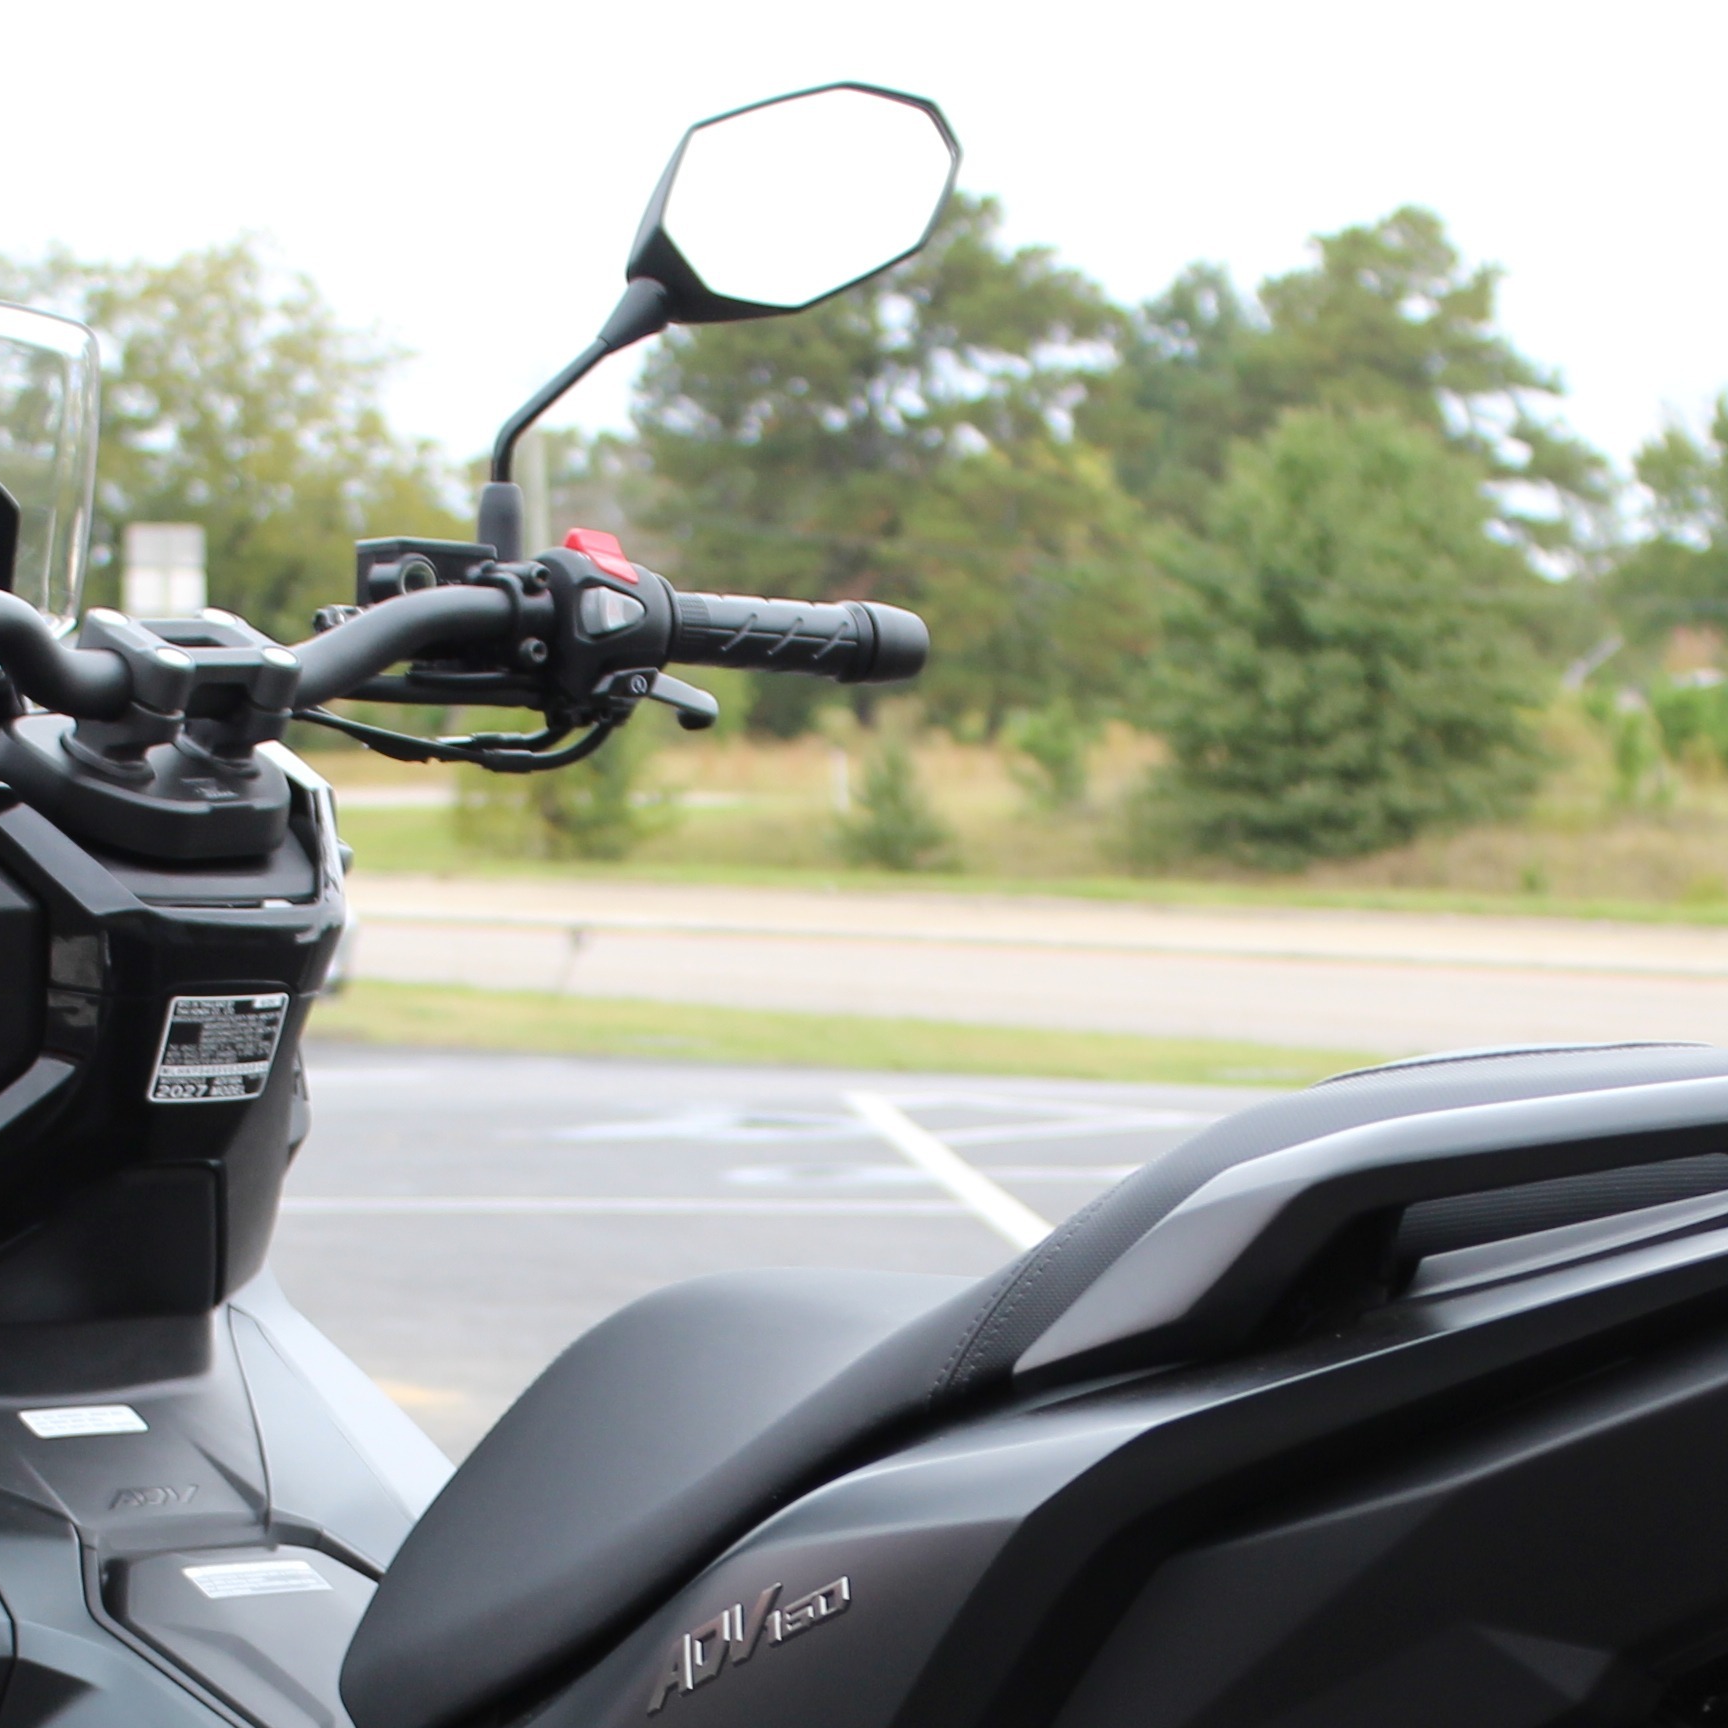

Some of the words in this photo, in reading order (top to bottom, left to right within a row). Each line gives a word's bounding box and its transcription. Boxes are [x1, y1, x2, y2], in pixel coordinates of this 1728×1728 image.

[155, 1084, 208, 1099] 2027
[109, 1483, 200, 1511] ADV
[647, 1582, 783, 1715] ADV
